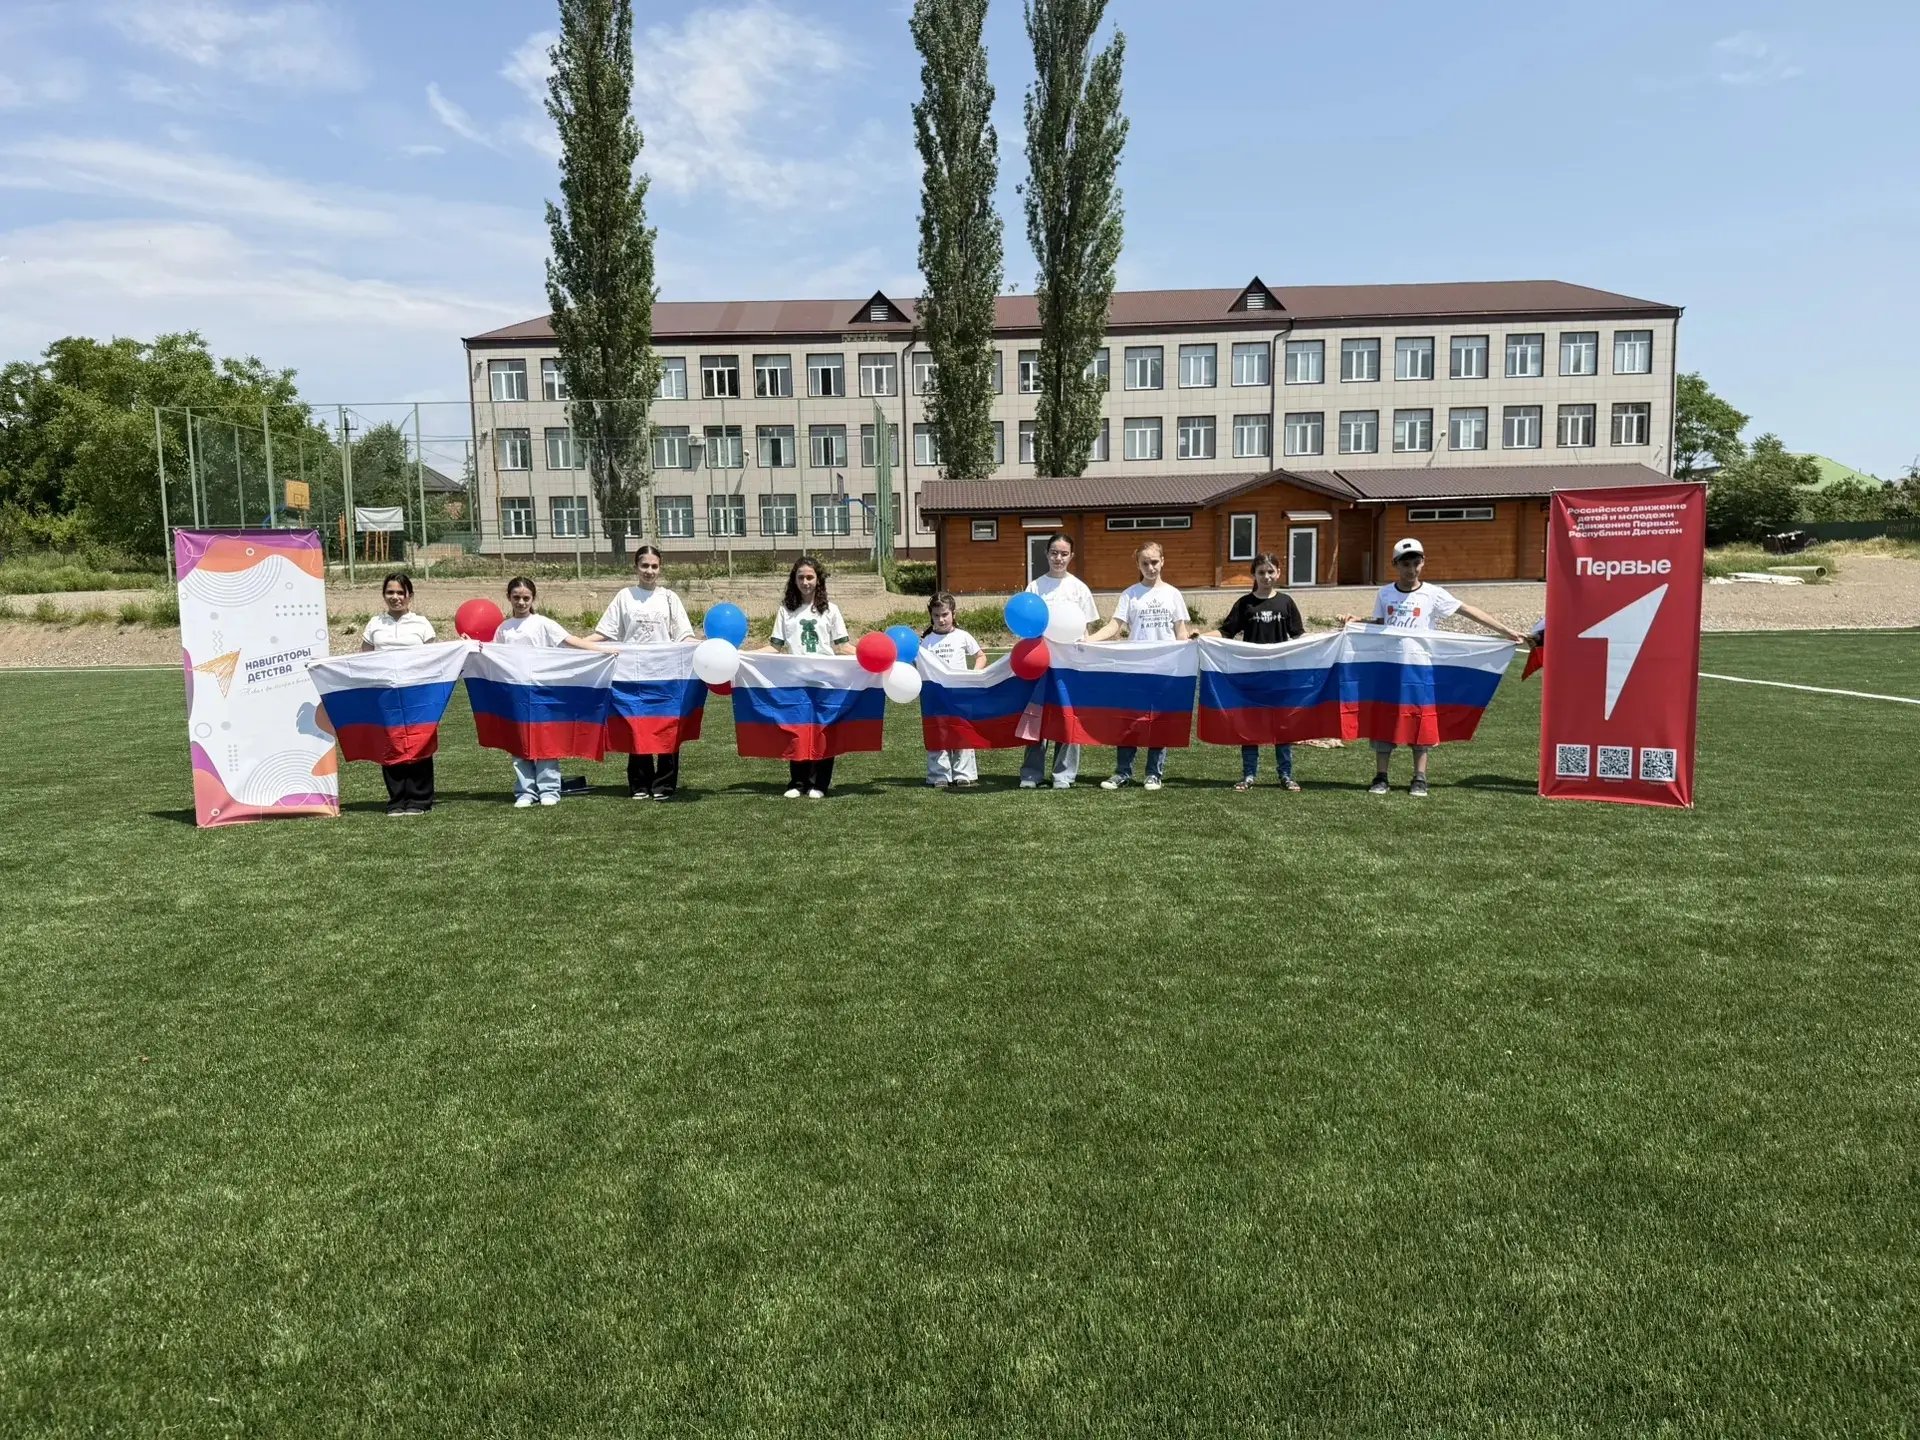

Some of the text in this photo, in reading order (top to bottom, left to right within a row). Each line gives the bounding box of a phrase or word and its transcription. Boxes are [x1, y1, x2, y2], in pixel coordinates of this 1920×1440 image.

[1567, 503, 1687, 514] Российское движение
[1577, 514, 1608, 522] детей
[1618, 512, 1675, 521] молодежи
[1572, 520, 1680, 531] «Движение Первых»
[1568, 527, 1683, 538] Республики Дагестан
[1576, 557, 1671, 581] Первые
[245, 648, 312, 670] НАВИГАТОРЫ
[248, 664, 292, 683] ДЕТСТВА
